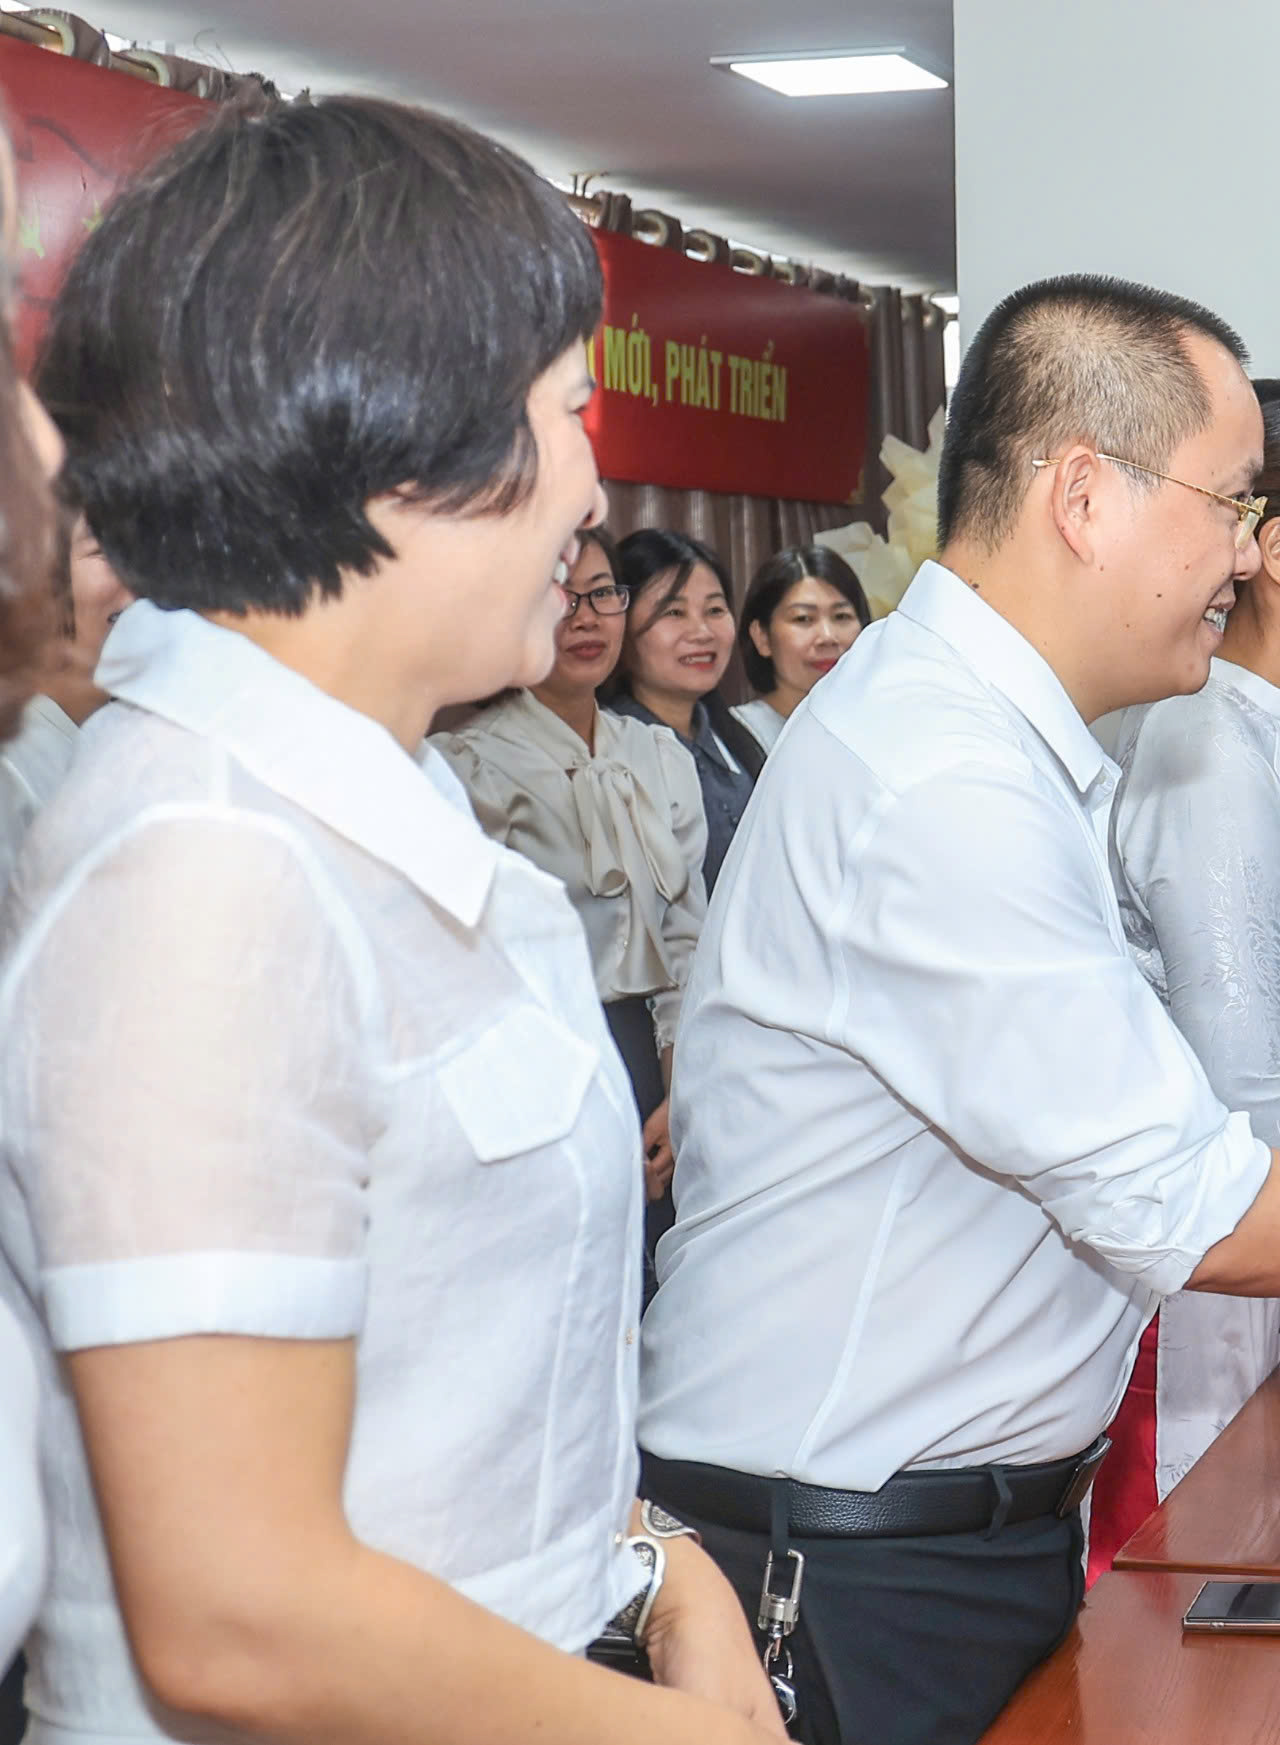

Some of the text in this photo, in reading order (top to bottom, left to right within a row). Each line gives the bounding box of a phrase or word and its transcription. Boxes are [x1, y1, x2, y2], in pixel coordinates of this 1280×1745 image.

[603, 312, 659, 407] MỚI,
[665, 333, 723, 412] PHÁT
[728, 339, 787, 422] TRIỂN
